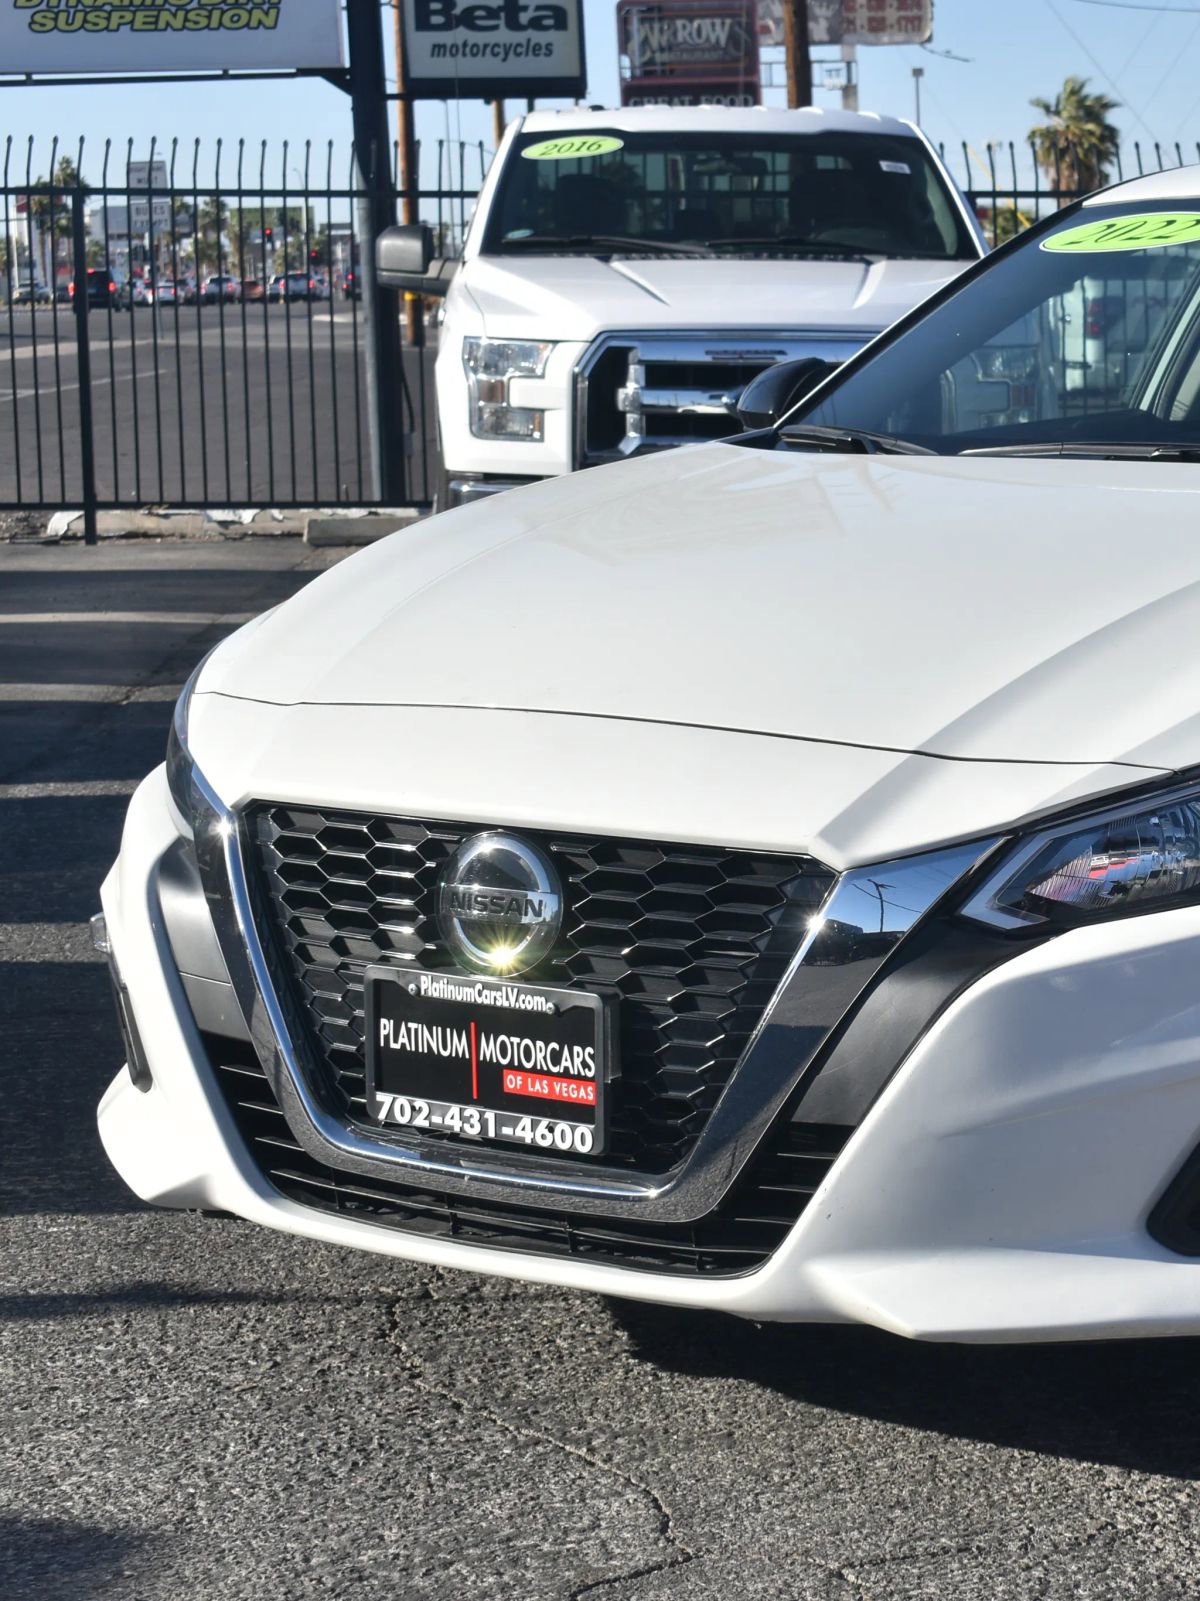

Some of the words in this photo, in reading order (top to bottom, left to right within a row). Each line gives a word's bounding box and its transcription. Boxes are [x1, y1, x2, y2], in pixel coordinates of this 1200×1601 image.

[29, 7, 280, 32] SUSPENSION
[414, 0, 568, 32] Beta
[430, 38, 554, 62] motorcycles
[539, 139, 608, 156] 2016
[452, 891, 544, 918] NISSAN
[420, 975, 547, 1012] PlatinumCarsLV.com
[380, 1018, 470, 1060] PLATINUM
[480, 1032, 596, 1078] MOTORCARS
[507, 1075, 523, 1090] OF
[528, 1078, 549, 1095] LAS
[554, 1081, 594, 1101] VEGAS
[376, 1095, 593, 1153] 702-431-4600
